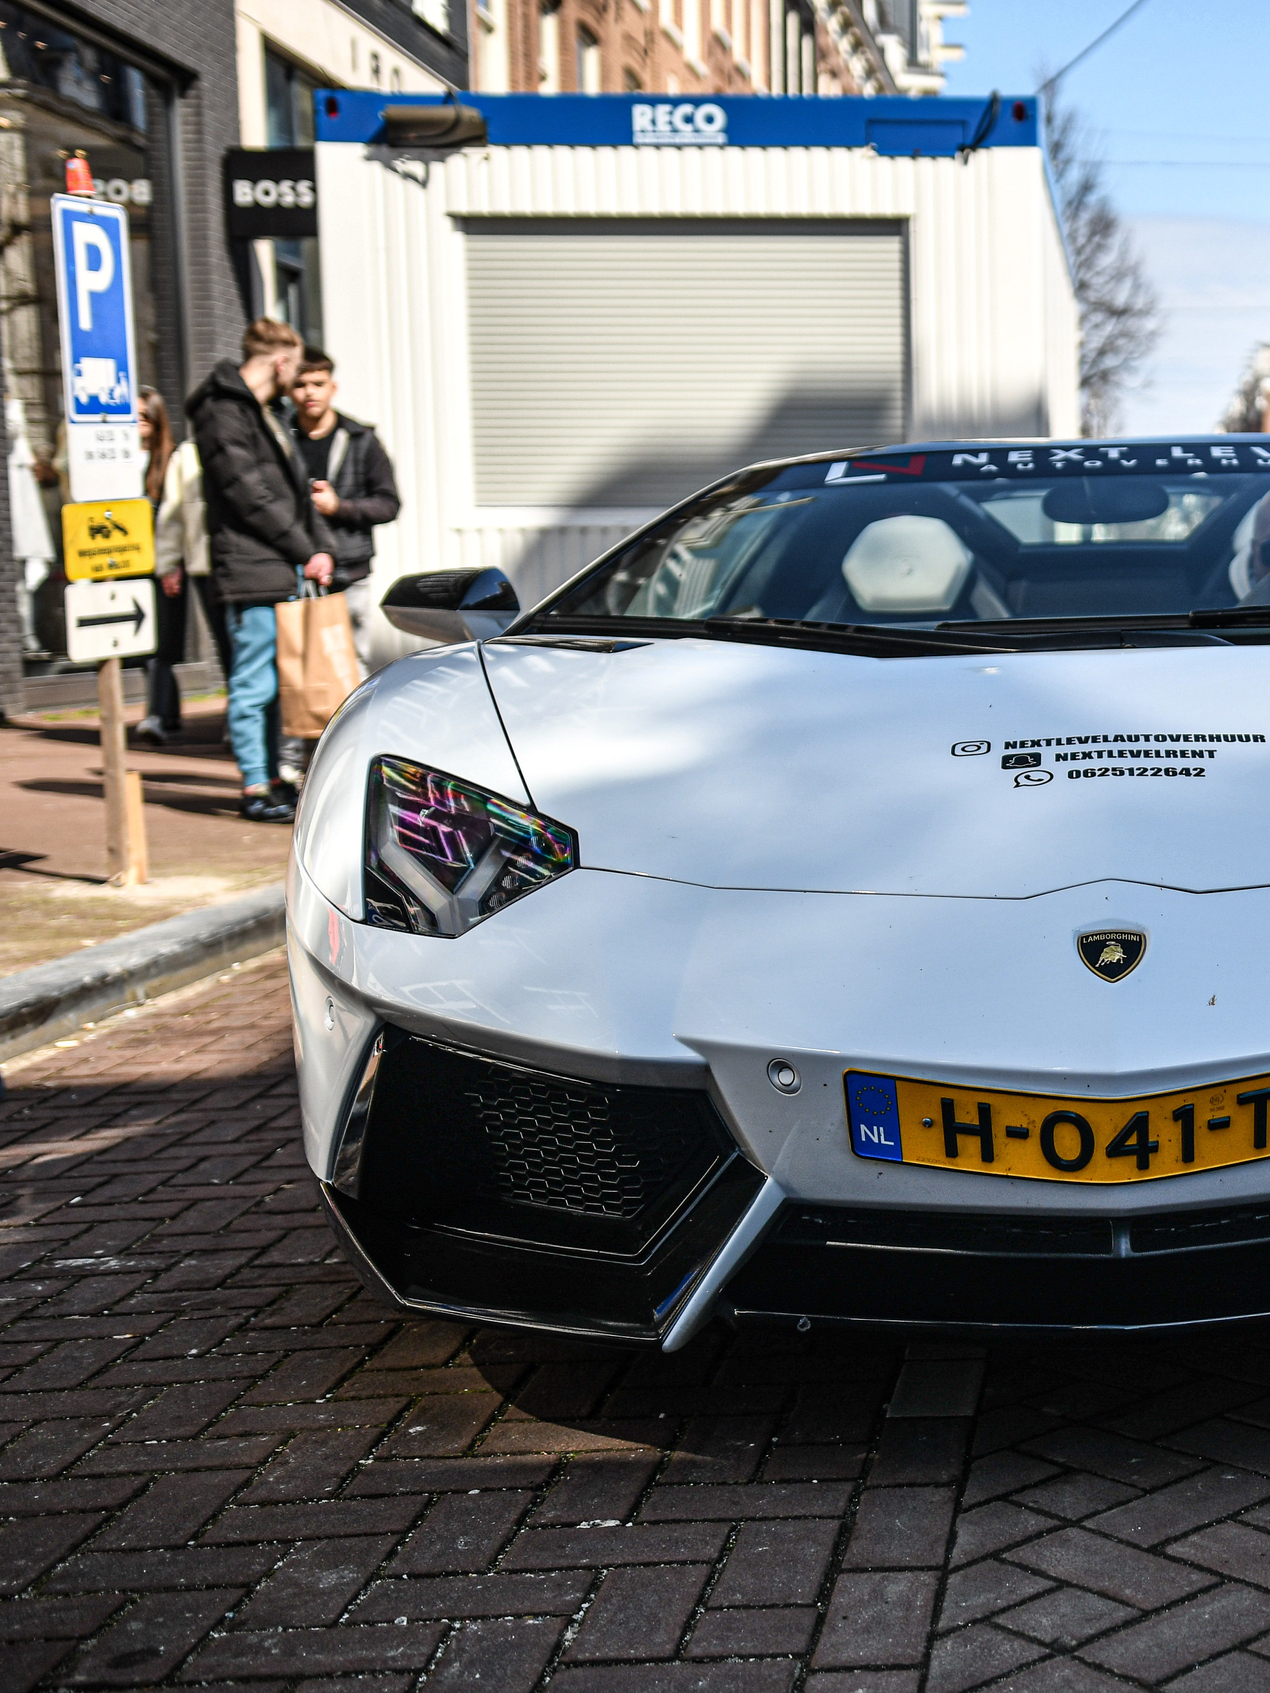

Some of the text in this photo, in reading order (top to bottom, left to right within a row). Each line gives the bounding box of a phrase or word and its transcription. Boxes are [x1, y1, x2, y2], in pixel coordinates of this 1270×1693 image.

[631, 102, 728, 132] RECO
[233, 179, 316, 208] BOSS
[72, 221, 114, 331] P
[951, 447, 1129, 468] NEXT
[1004, 733, 1266, 750] NEXTLEVELAUTOVERHUUR
[1054, 749, 1218, 762] NEXTLEVELRENT
[1067, 766, 1207, 780] 0625122642
[1083, 933, 1140, 944] LAMBORGHINI
[860, 1123, 894, 1148] NL
